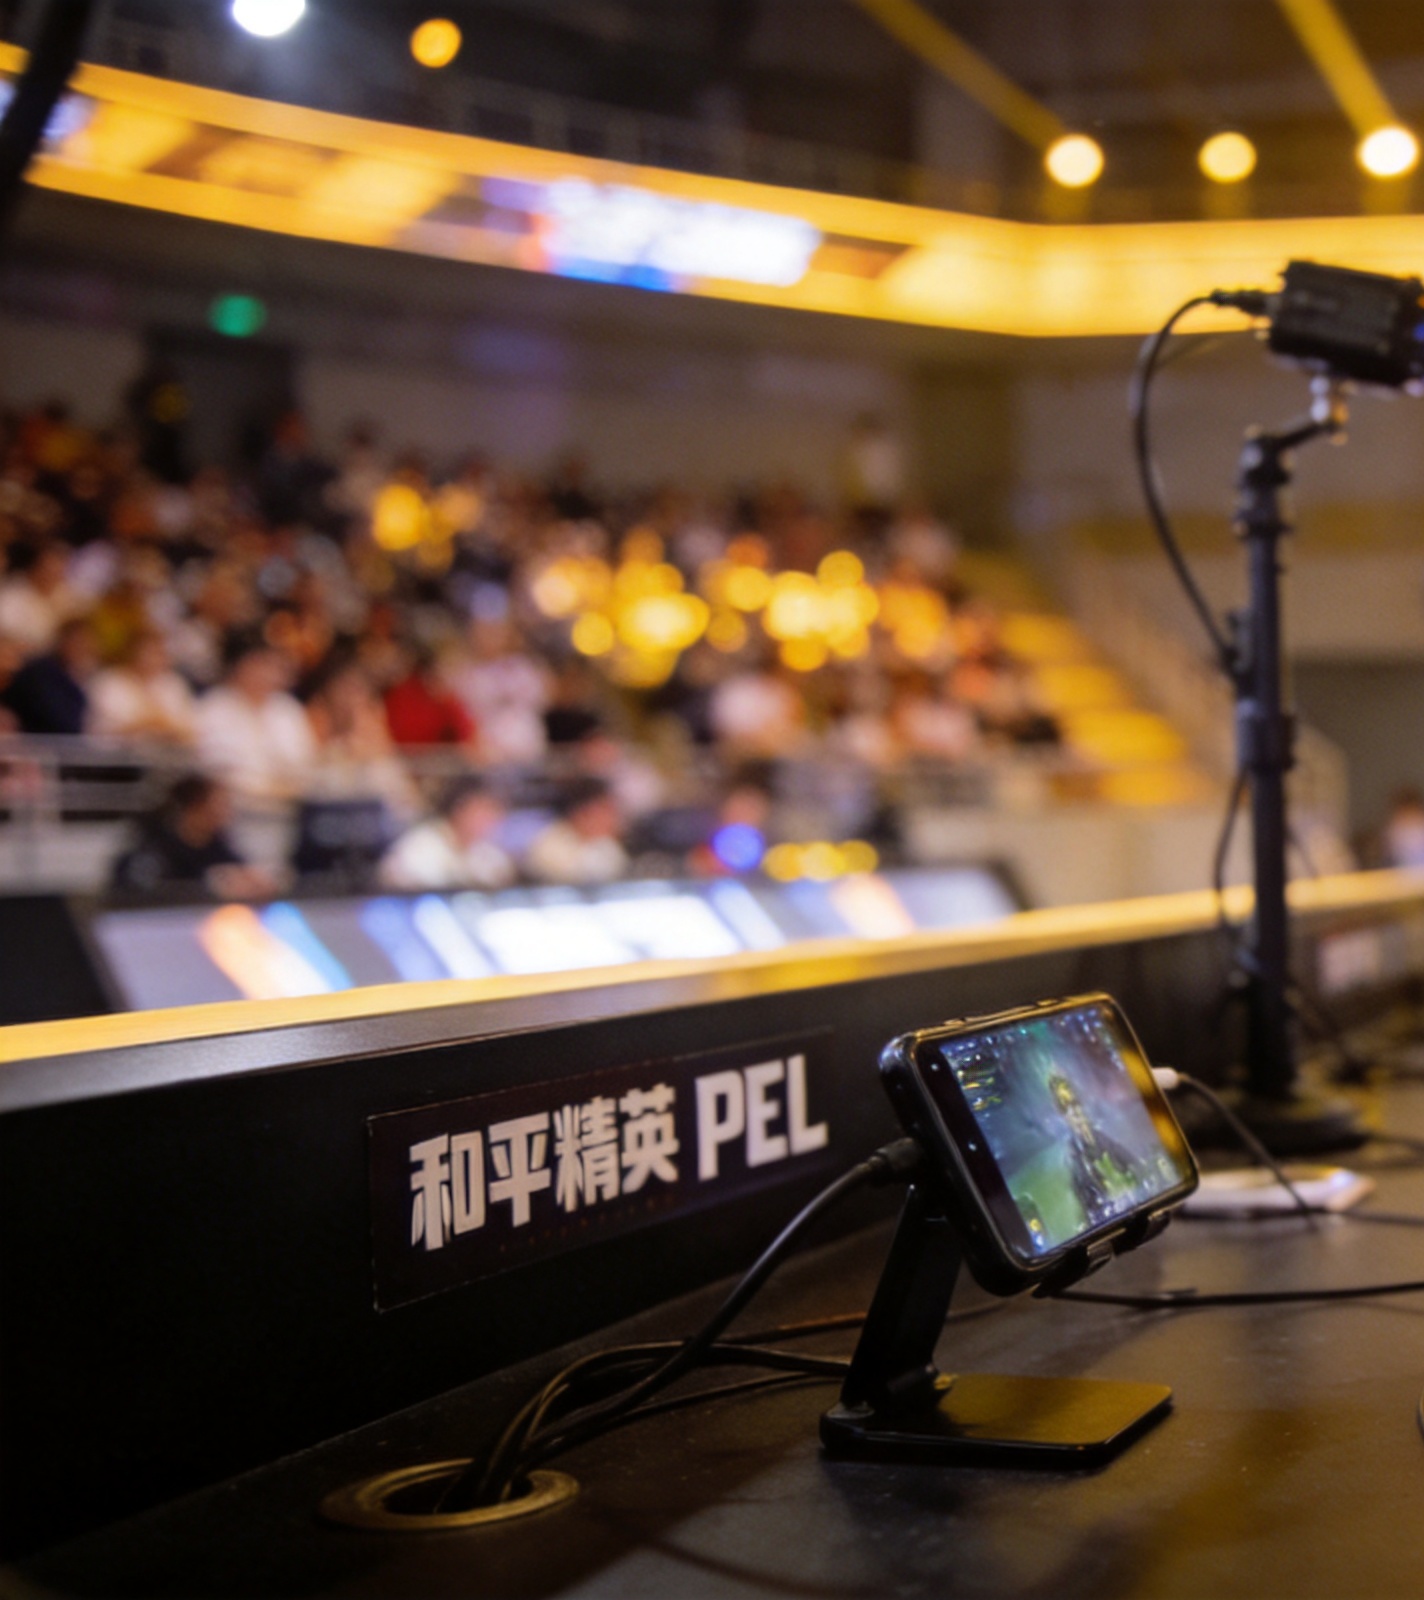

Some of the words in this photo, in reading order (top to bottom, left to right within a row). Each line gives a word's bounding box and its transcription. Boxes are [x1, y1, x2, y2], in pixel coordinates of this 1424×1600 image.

[409, 1082, 679, 1250] 和平精英
[696, 1054, 828, 1181] PEL
